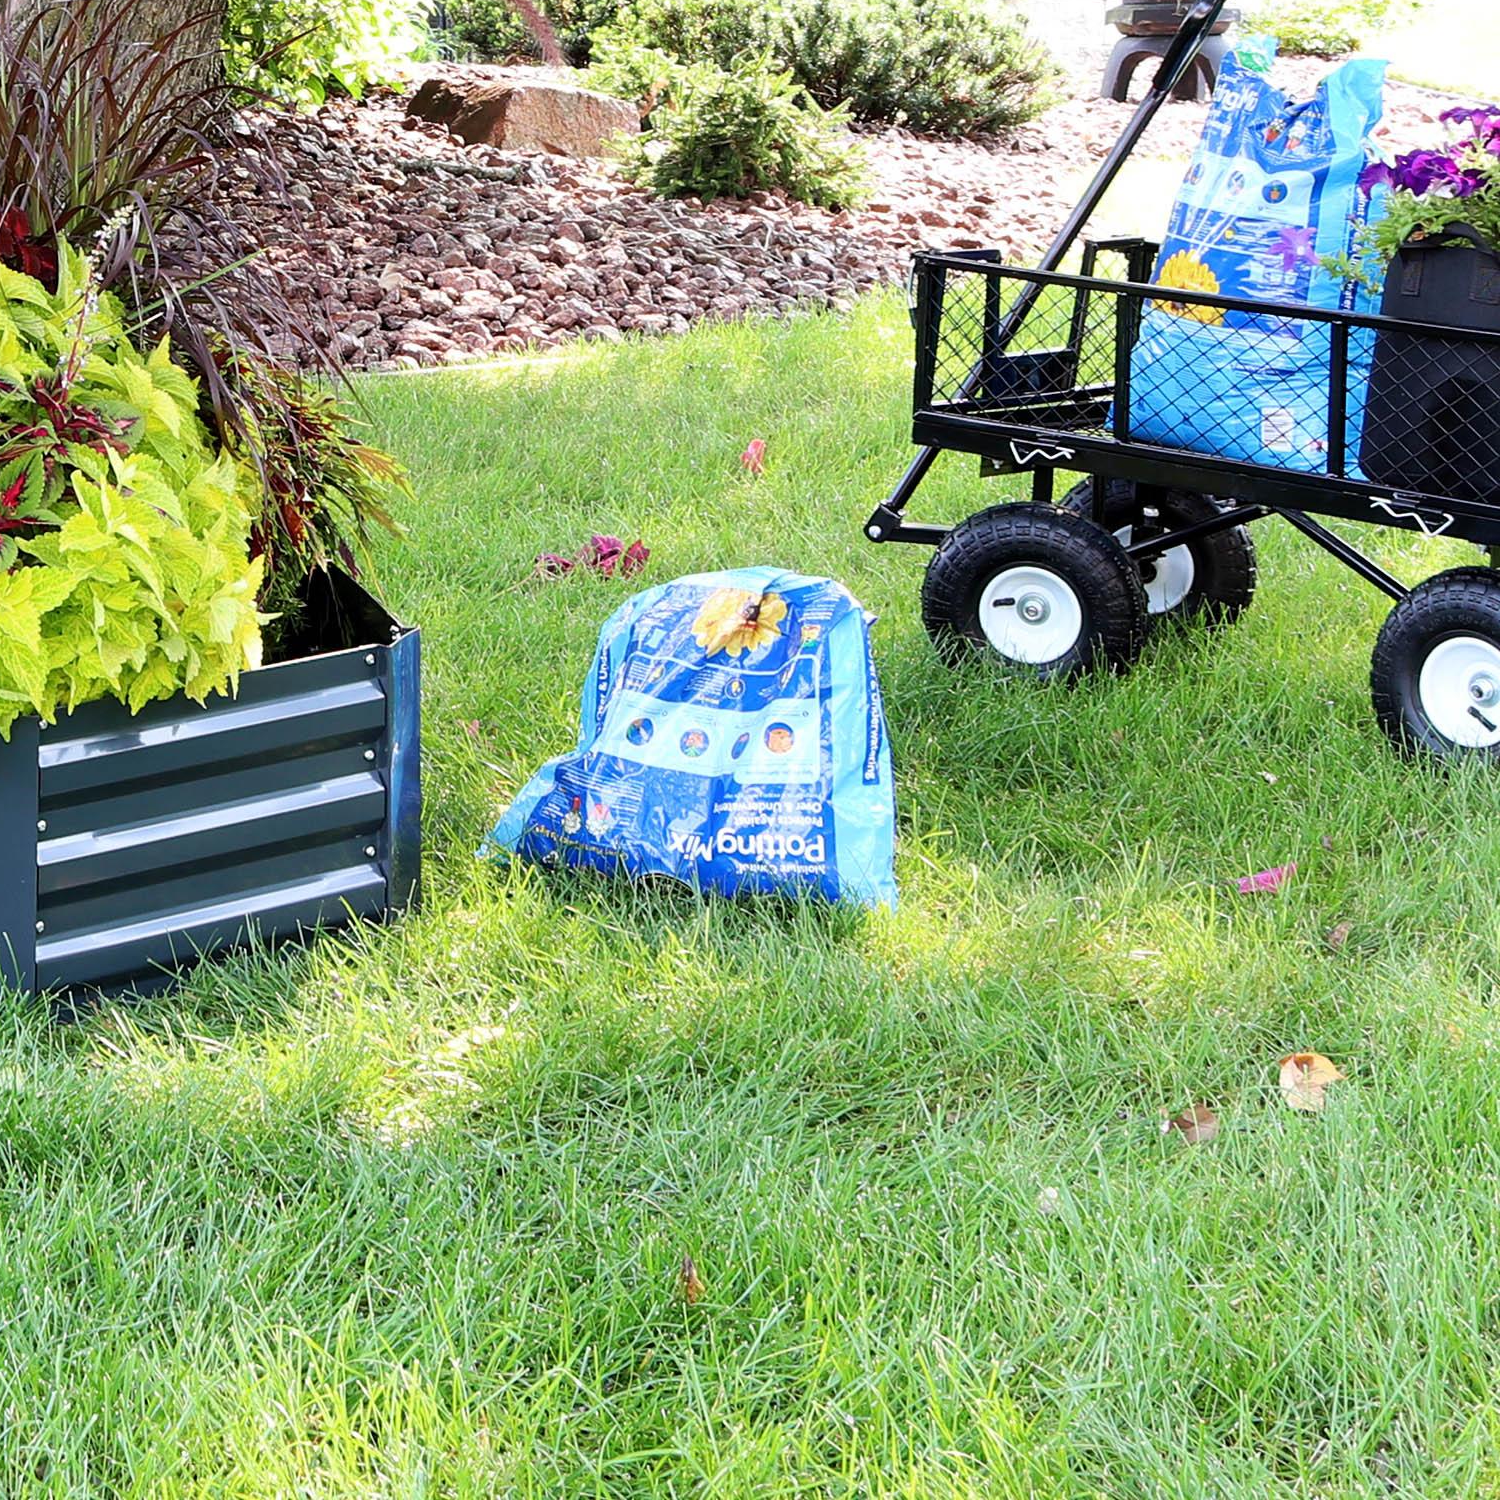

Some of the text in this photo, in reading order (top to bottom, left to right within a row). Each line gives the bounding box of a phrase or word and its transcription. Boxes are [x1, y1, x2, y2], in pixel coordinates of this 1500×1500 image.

[598, 682, 608, 691] &
[795, 802, 823, 813] Over
[734, 814, 824, 828] Protects Against
[669, 827, 826, 863] Potting Mix
[779, 863, 827, 874] Moisture
